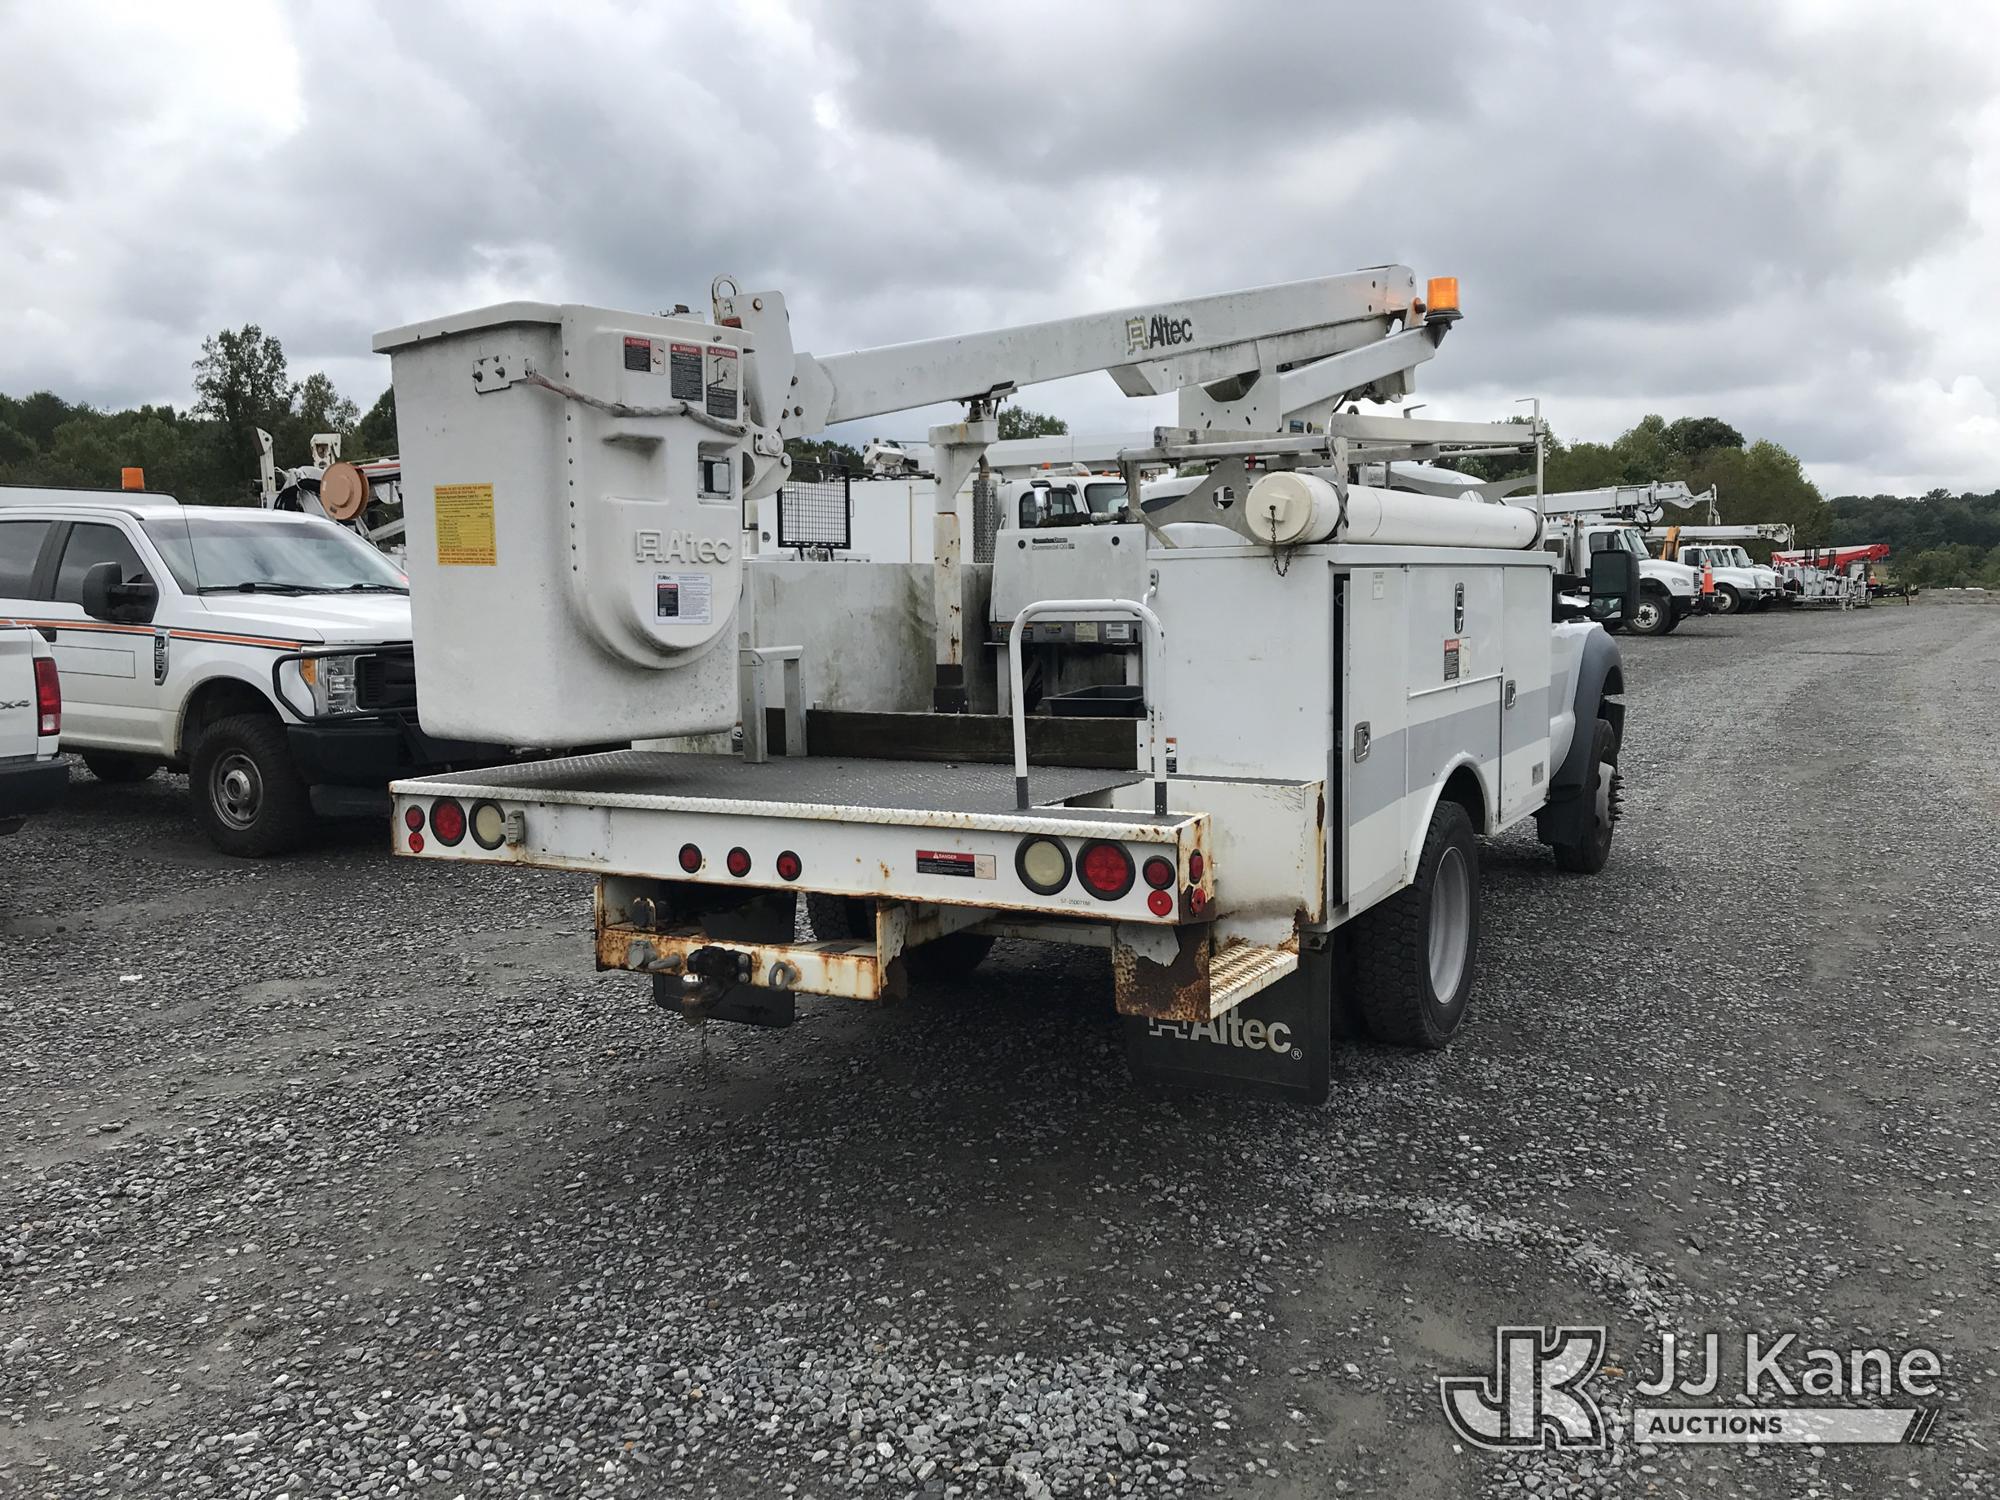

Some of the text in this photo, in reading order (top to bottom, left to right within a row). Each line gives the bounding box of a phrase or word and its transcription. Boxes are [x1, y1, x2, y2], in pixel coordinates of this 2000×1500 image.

[1149, 315, 1193, 349] Altec
[664, 529, 734, 564] Altec
[938, 853, 957, 861] DANGER
